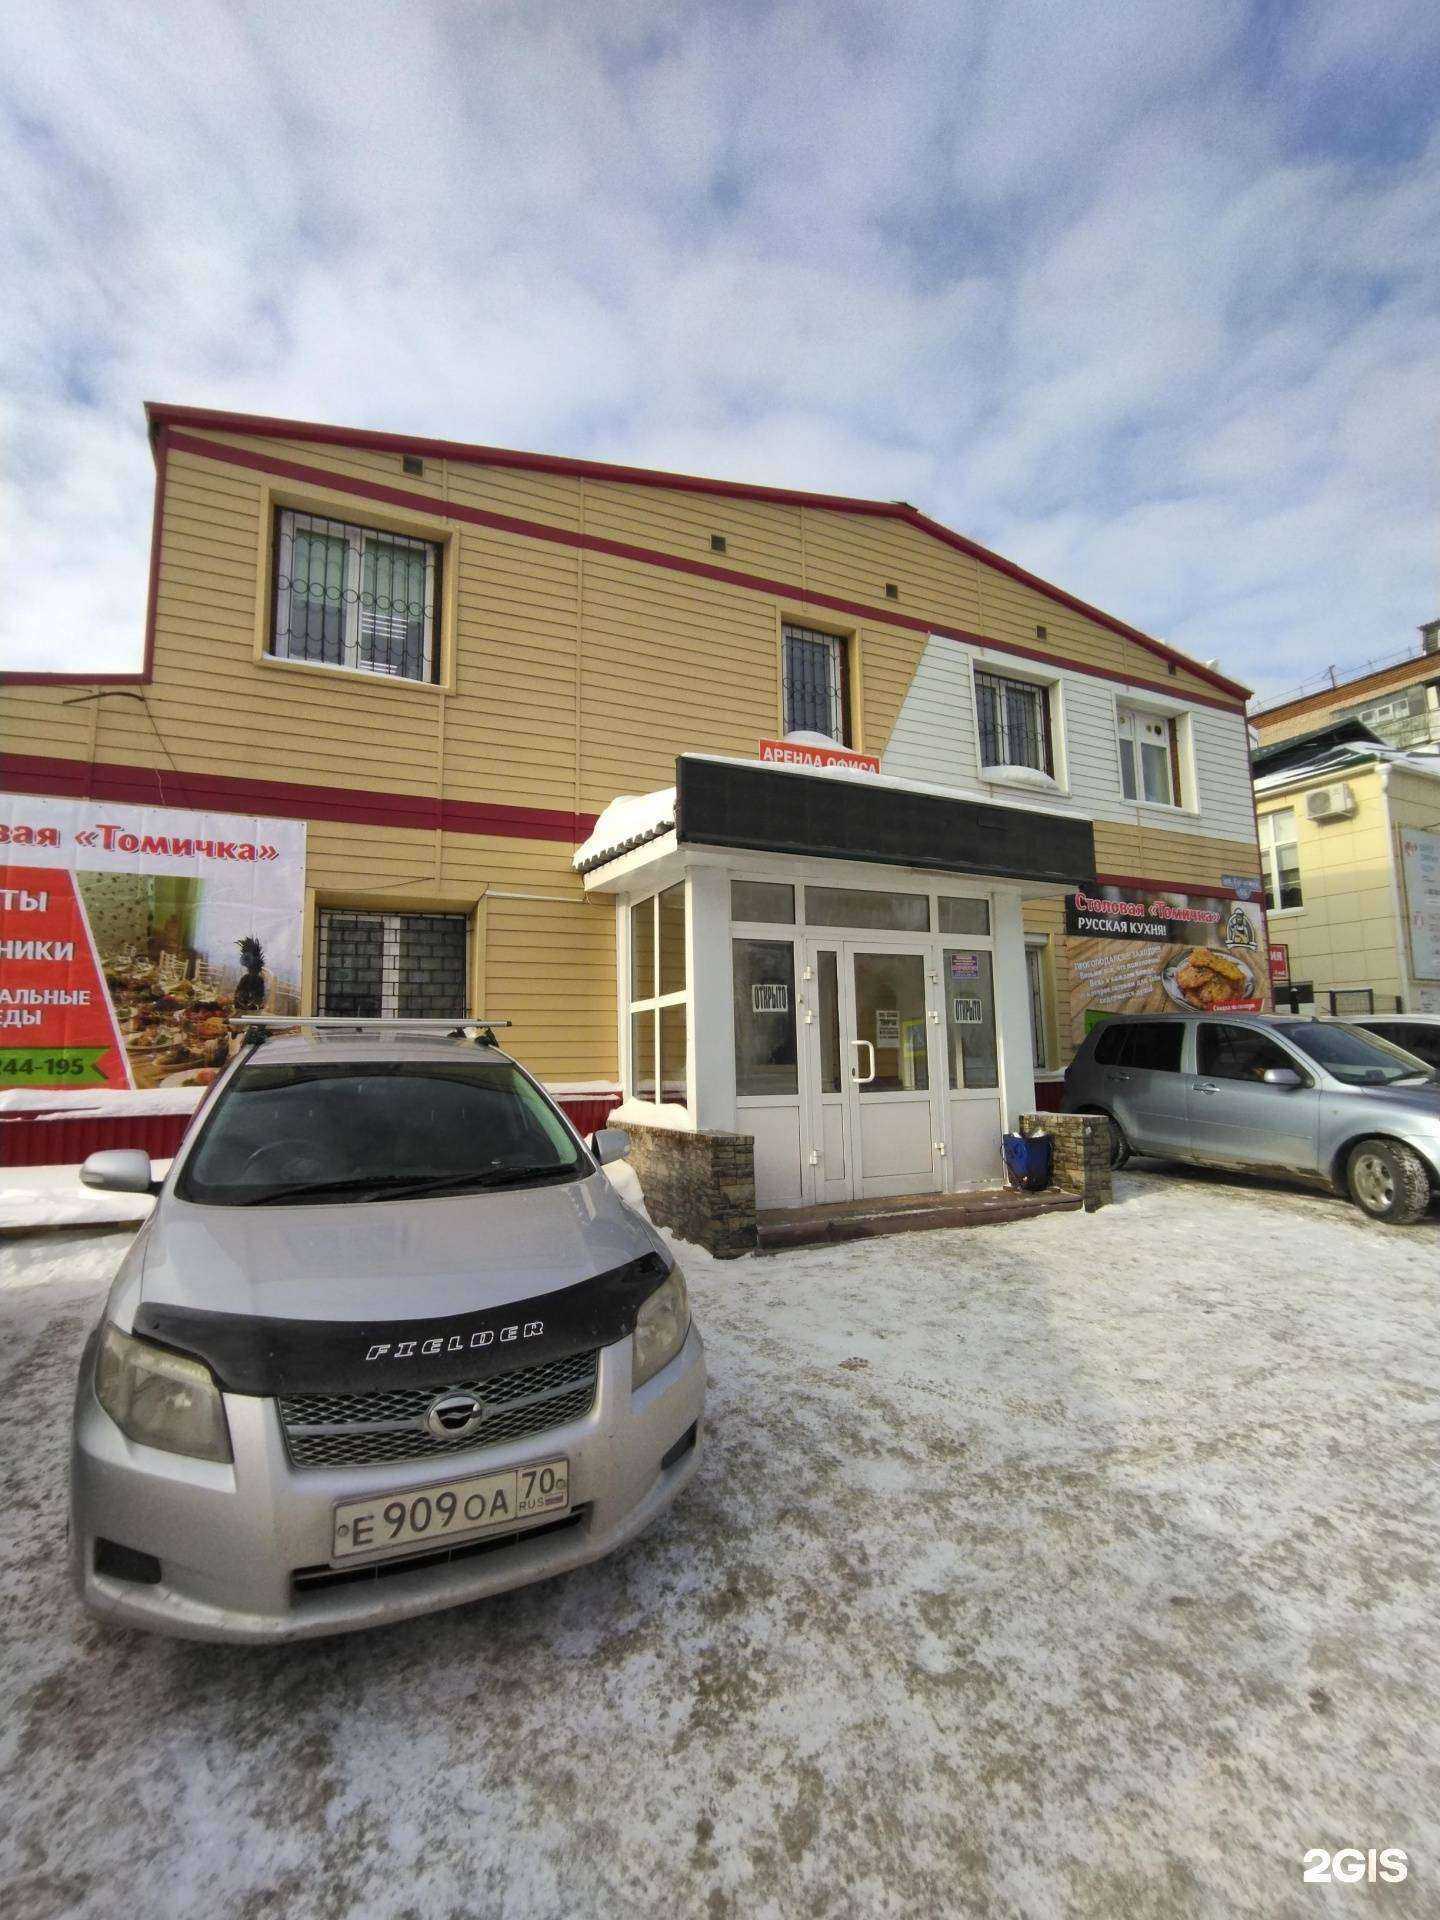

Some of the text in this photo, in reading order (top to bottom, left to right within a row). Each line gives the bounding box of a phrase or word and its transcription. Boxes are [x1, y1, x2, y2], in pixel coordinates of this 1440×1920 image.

[762, 746, 823, 768] АРЕНДА
[74, 823, 281, 863] «Томичка»
[1074, 892, 1145, 917] Столовая
[1078, 917, 1128, 933] РУССКАЯ
[754, 985, 787, 1010] ОТКРЫТО
[955, 1000, 981, 1021] ОТКРЫТО
[0, 1056, 84, 1075] 44-195
[366, 1321, 544, 1361] FIELDER
[521, 1467, 556, 1498] 70
[518, 1496, 545, 1511] RUS
